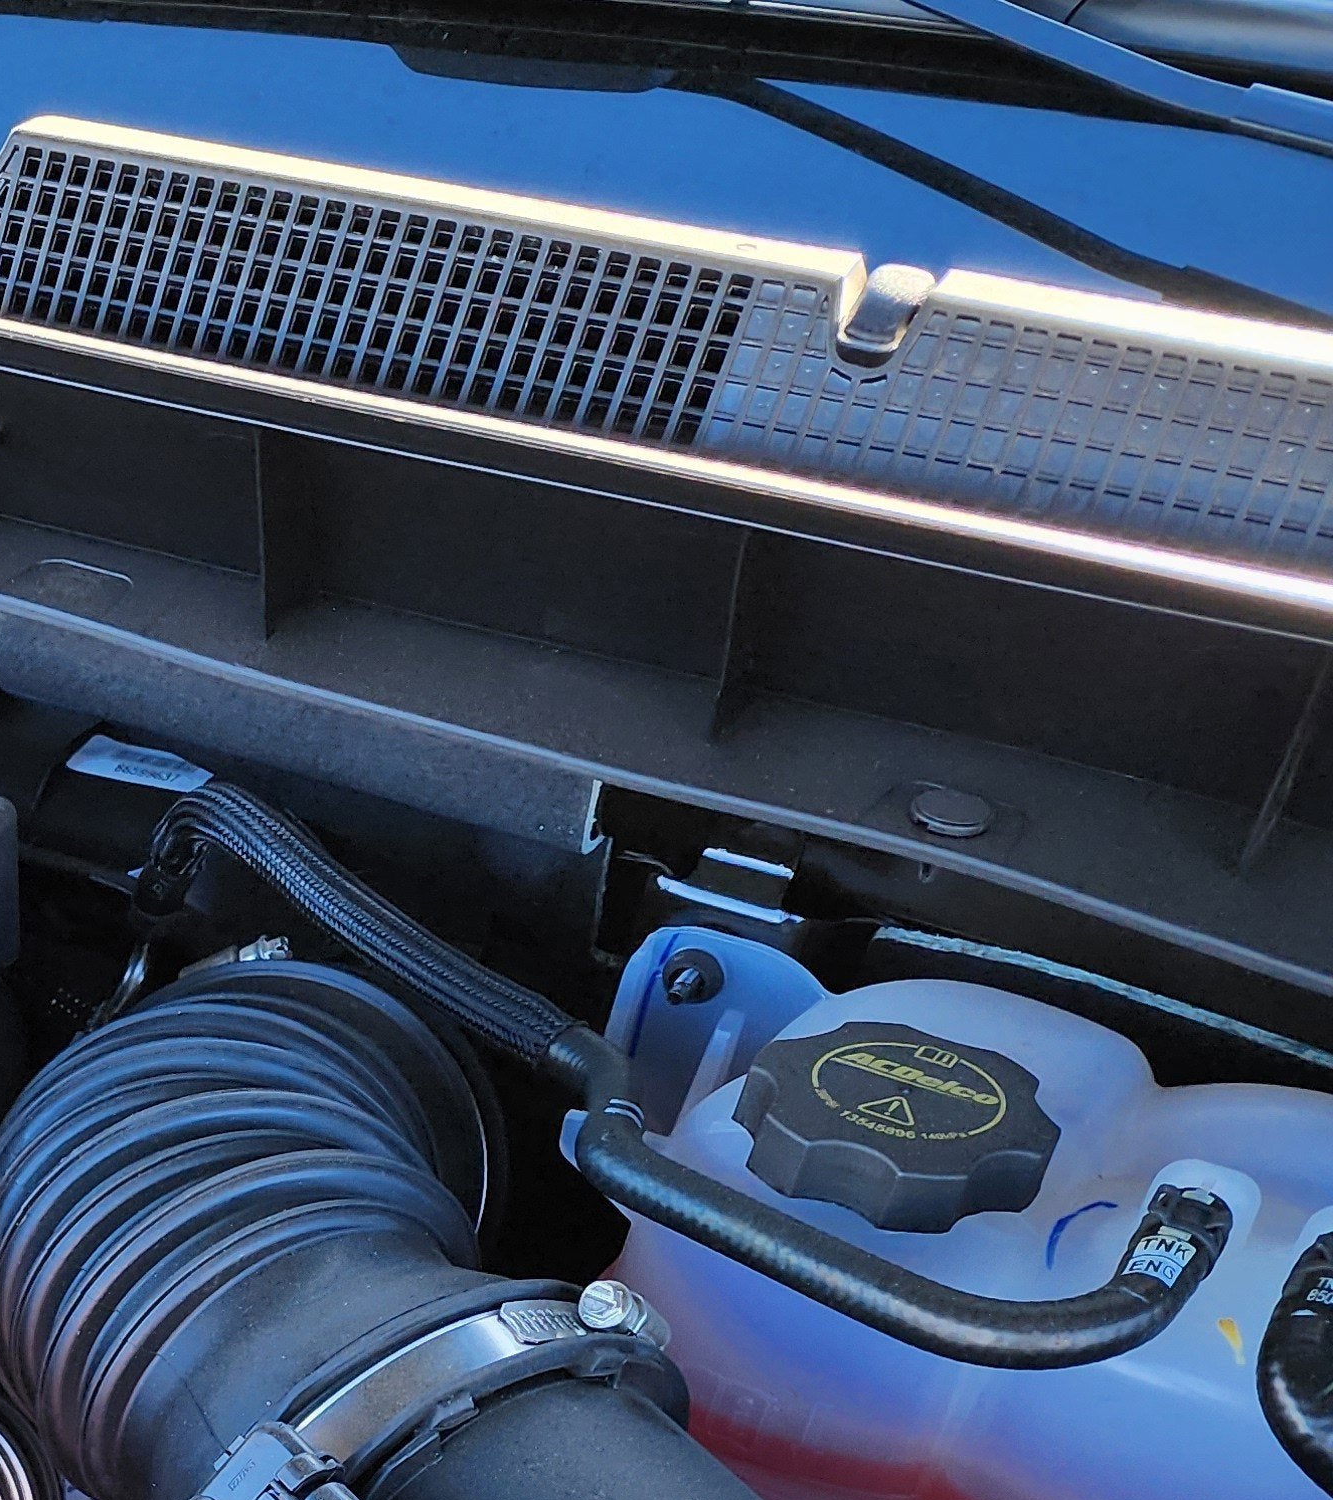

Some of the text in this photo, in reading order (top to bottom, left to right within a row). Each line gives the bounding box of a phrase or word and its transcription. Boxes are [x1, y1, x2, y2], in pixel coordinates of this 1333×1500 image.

[837, 1052, 1000, 1105] ACDelco
[1142, 1238, 1189, 1260] TNK
[1129, 1257, 1175, 1279] ENG
